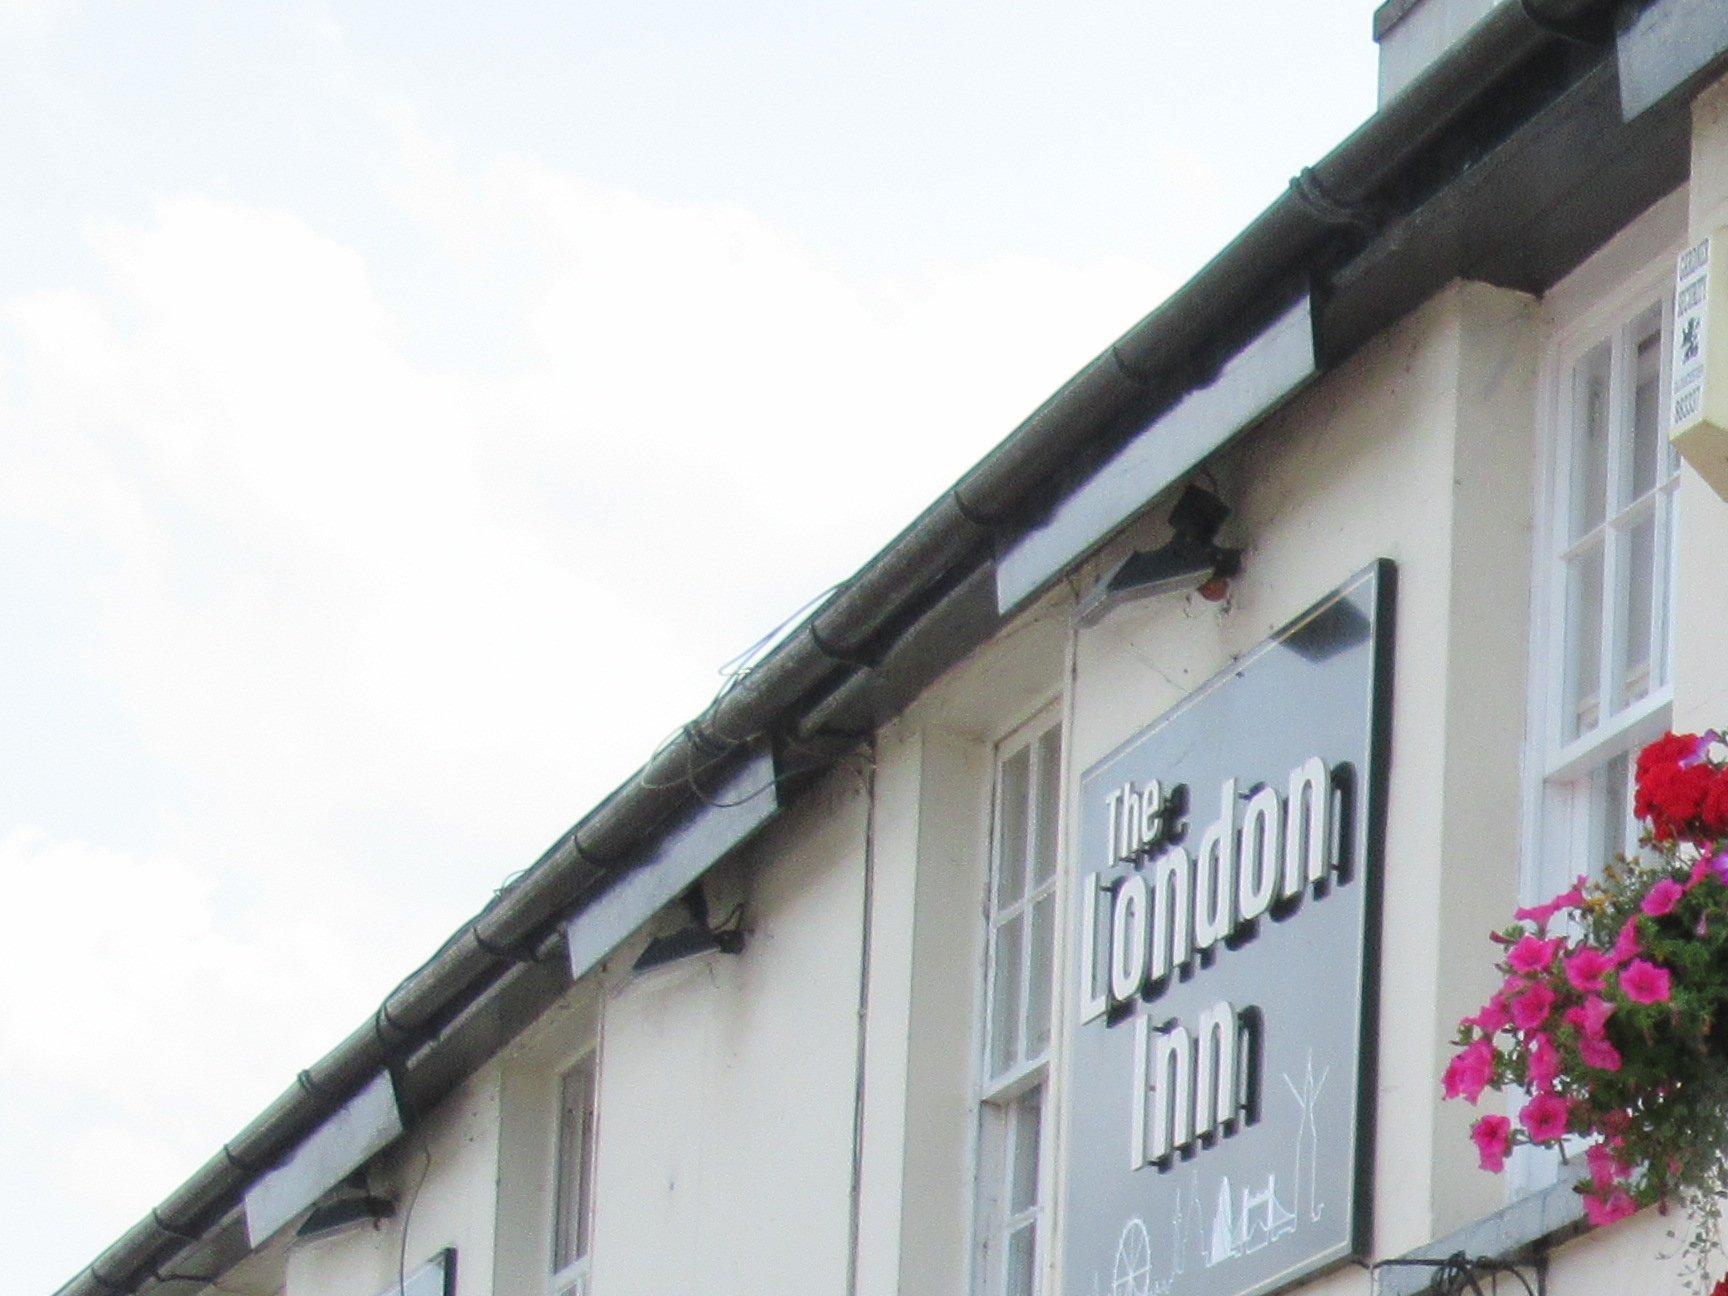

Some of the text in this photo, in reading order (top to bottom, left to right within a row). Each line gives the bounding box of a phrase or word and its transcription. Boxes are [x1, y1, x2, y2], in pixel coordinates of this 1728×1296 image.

[1080, 752, 1341, 1026] London
[1105, 776, 1164, 867] The
[1131, 998, 1249, 1172] Inn
